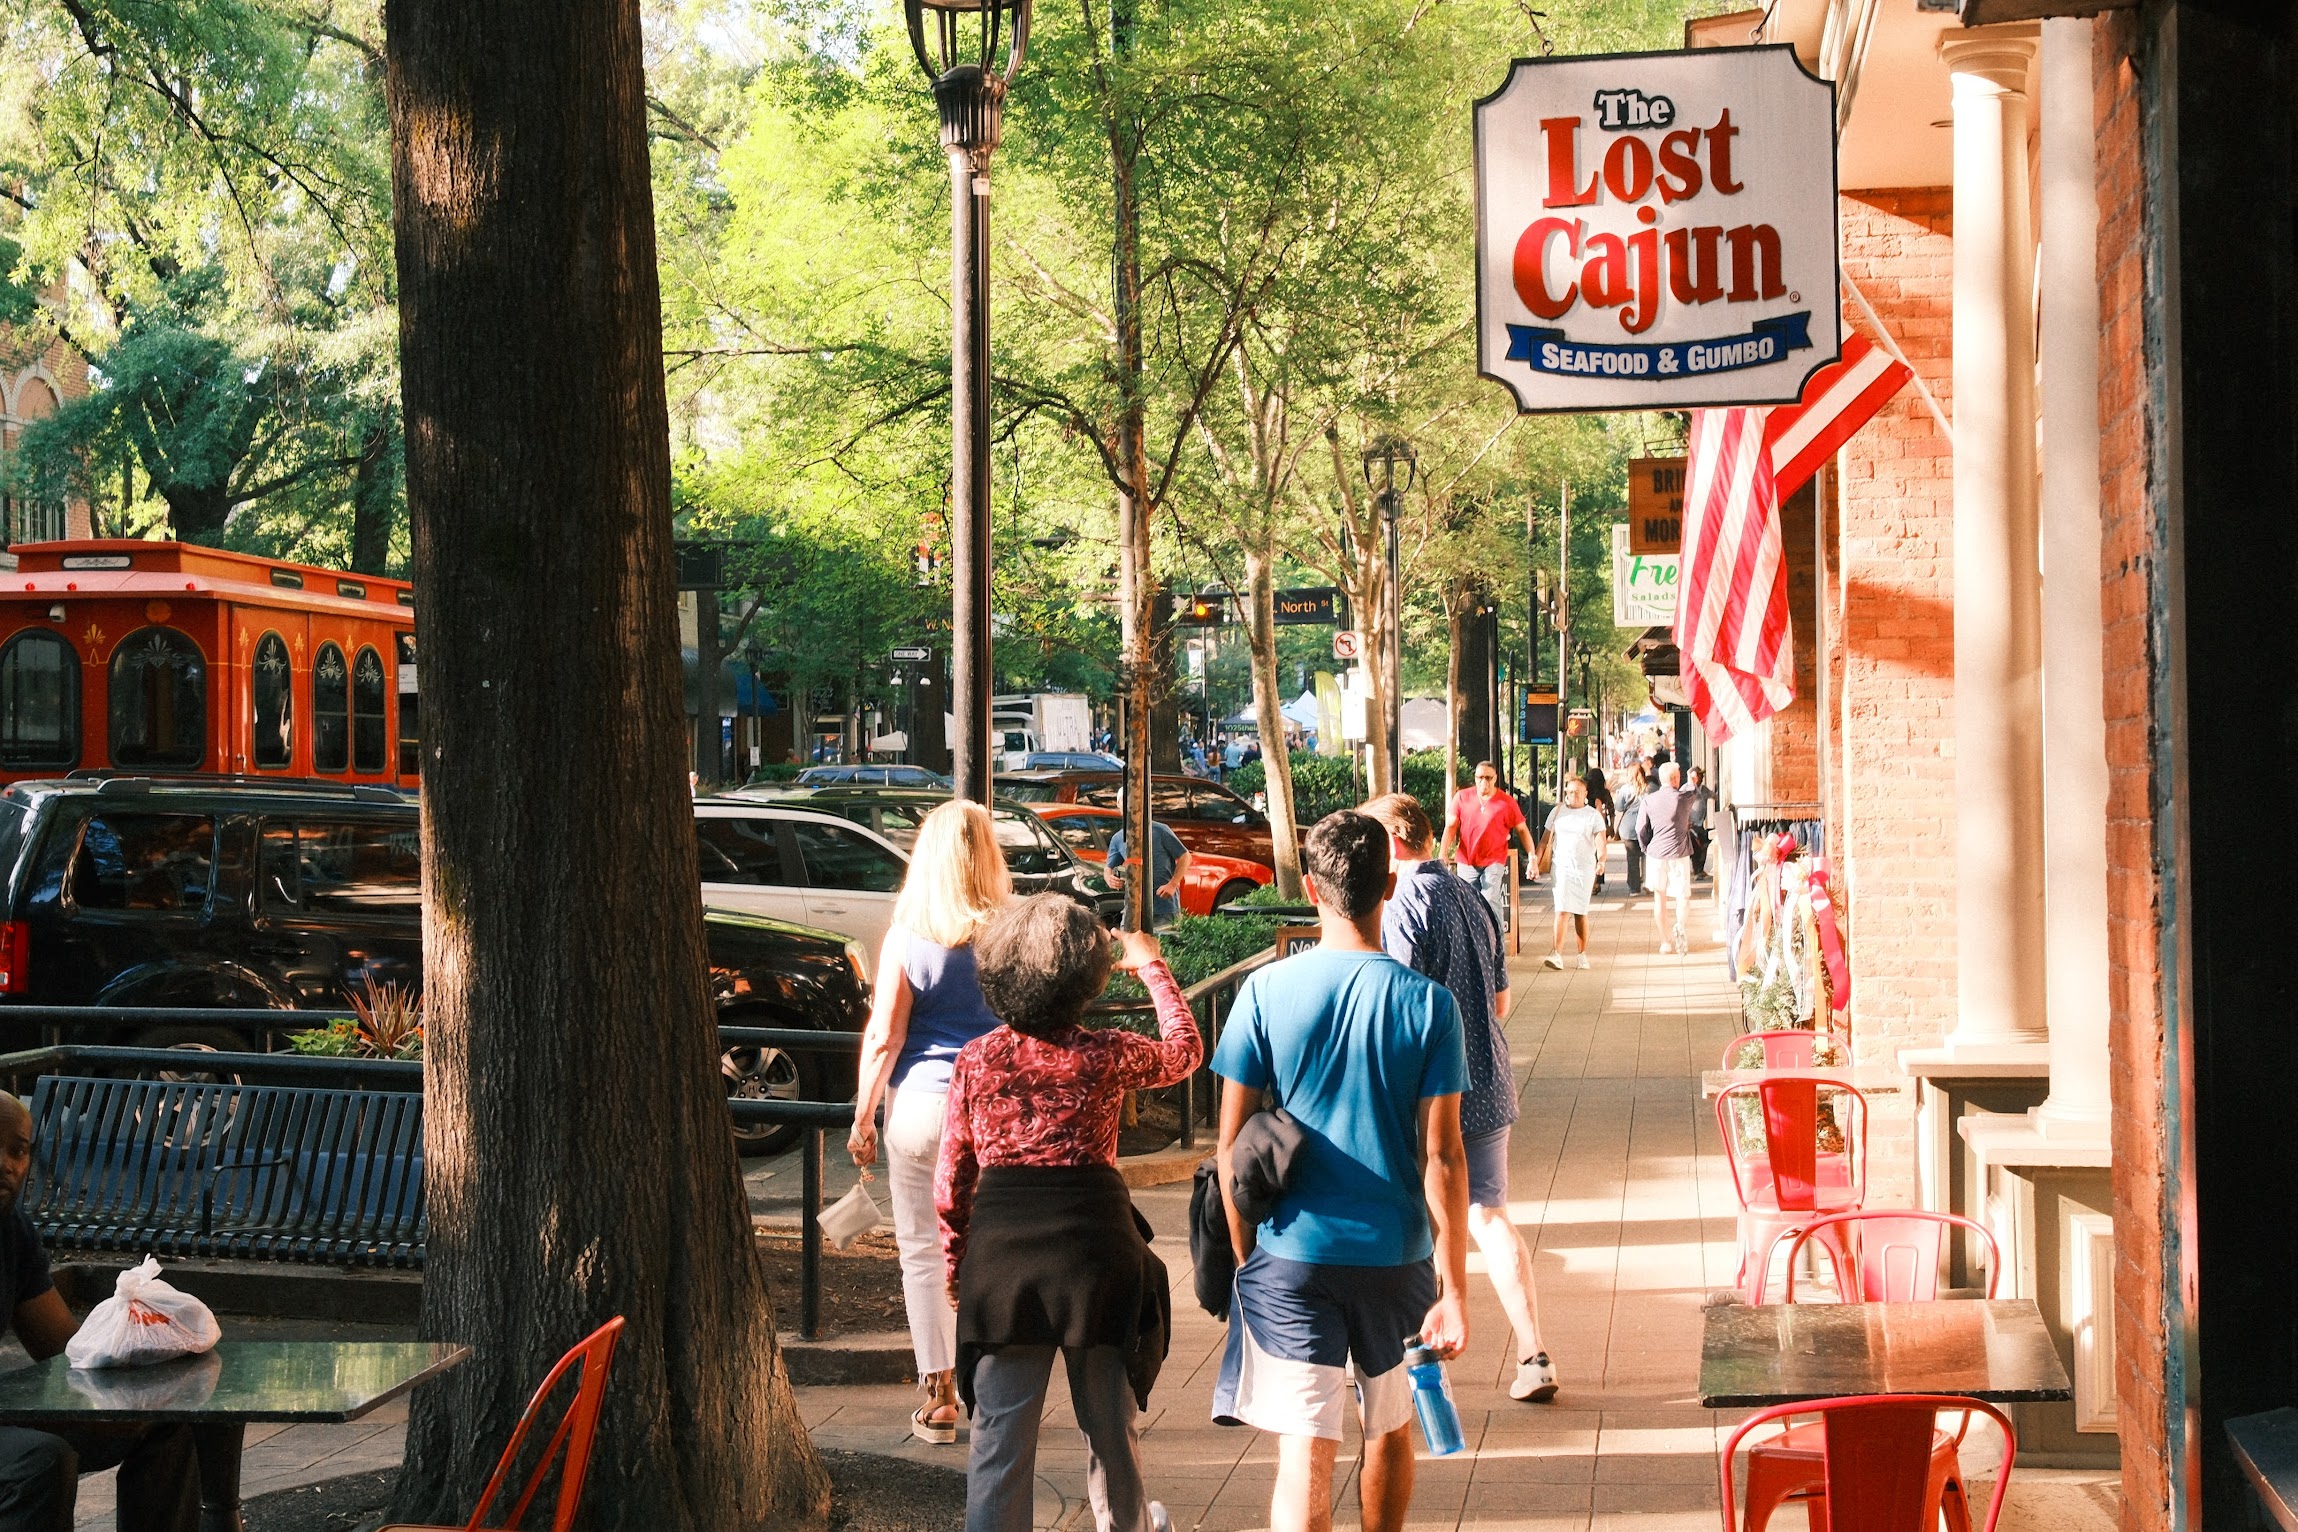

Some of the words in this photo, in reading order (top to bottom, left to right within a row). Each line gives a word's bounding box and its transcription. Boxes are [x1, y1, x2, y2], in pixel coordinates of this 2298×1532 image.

[1595, 90, 1674, 129] The
[1540, 108, 1744, 208] Lost
[1512, 205, 1787, 334] Cajun
[1542, 343, 1649, 375] SEAFOOD
[1657, 348, 1679, 373] &
[1687, 337, 1774, 371] GUMBO
[1644, 517, 1681, 543] MOR
[1280, 601, 1316, 613] North
[1631, 592, 1676, 601] Salads
[1519, 710, 1526, 719] to
